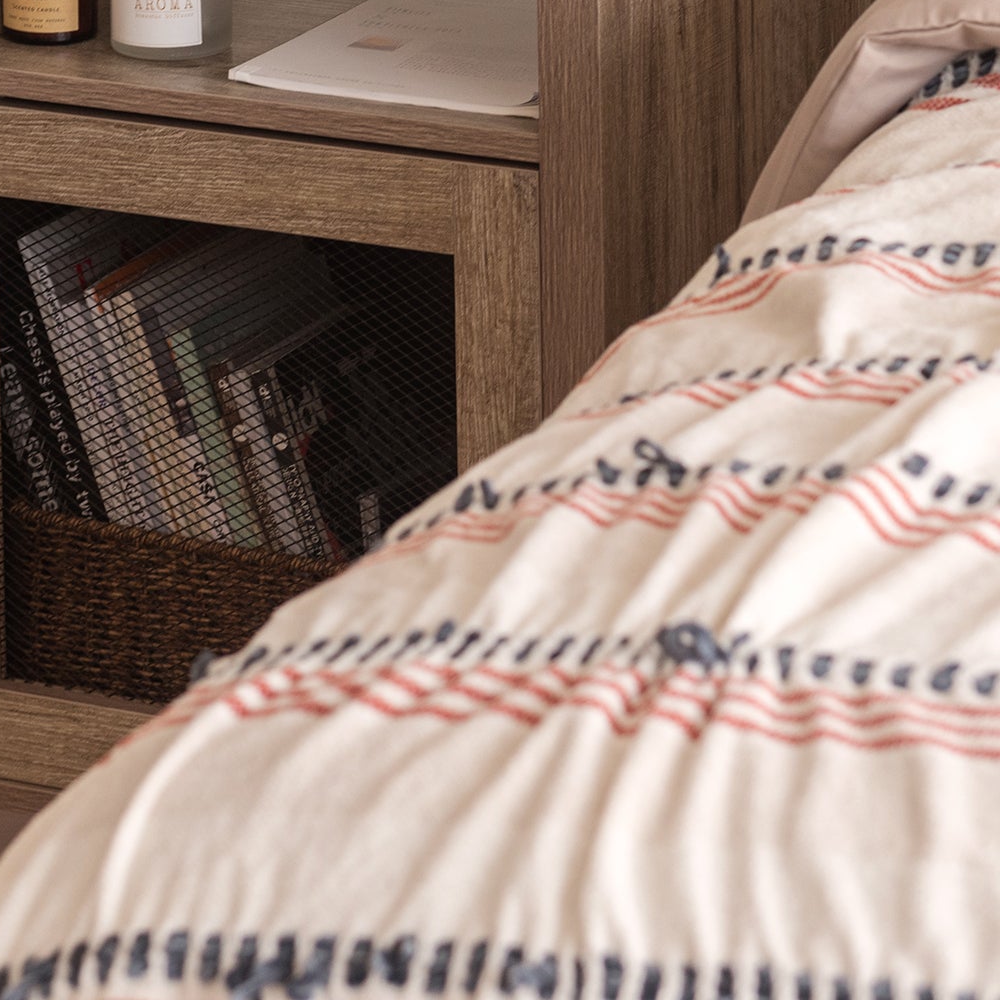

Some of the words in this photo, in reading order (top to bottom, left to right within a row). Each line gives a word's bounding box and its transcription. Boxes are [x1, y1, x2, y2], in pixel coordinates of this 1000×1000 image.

[18, 310, 46, 367] Chess
[37, 369, 53, 386] is
[40, 388, 77, 456] played
[64, 457, 82, 484] by
[75, 489, 94, 520] tw
